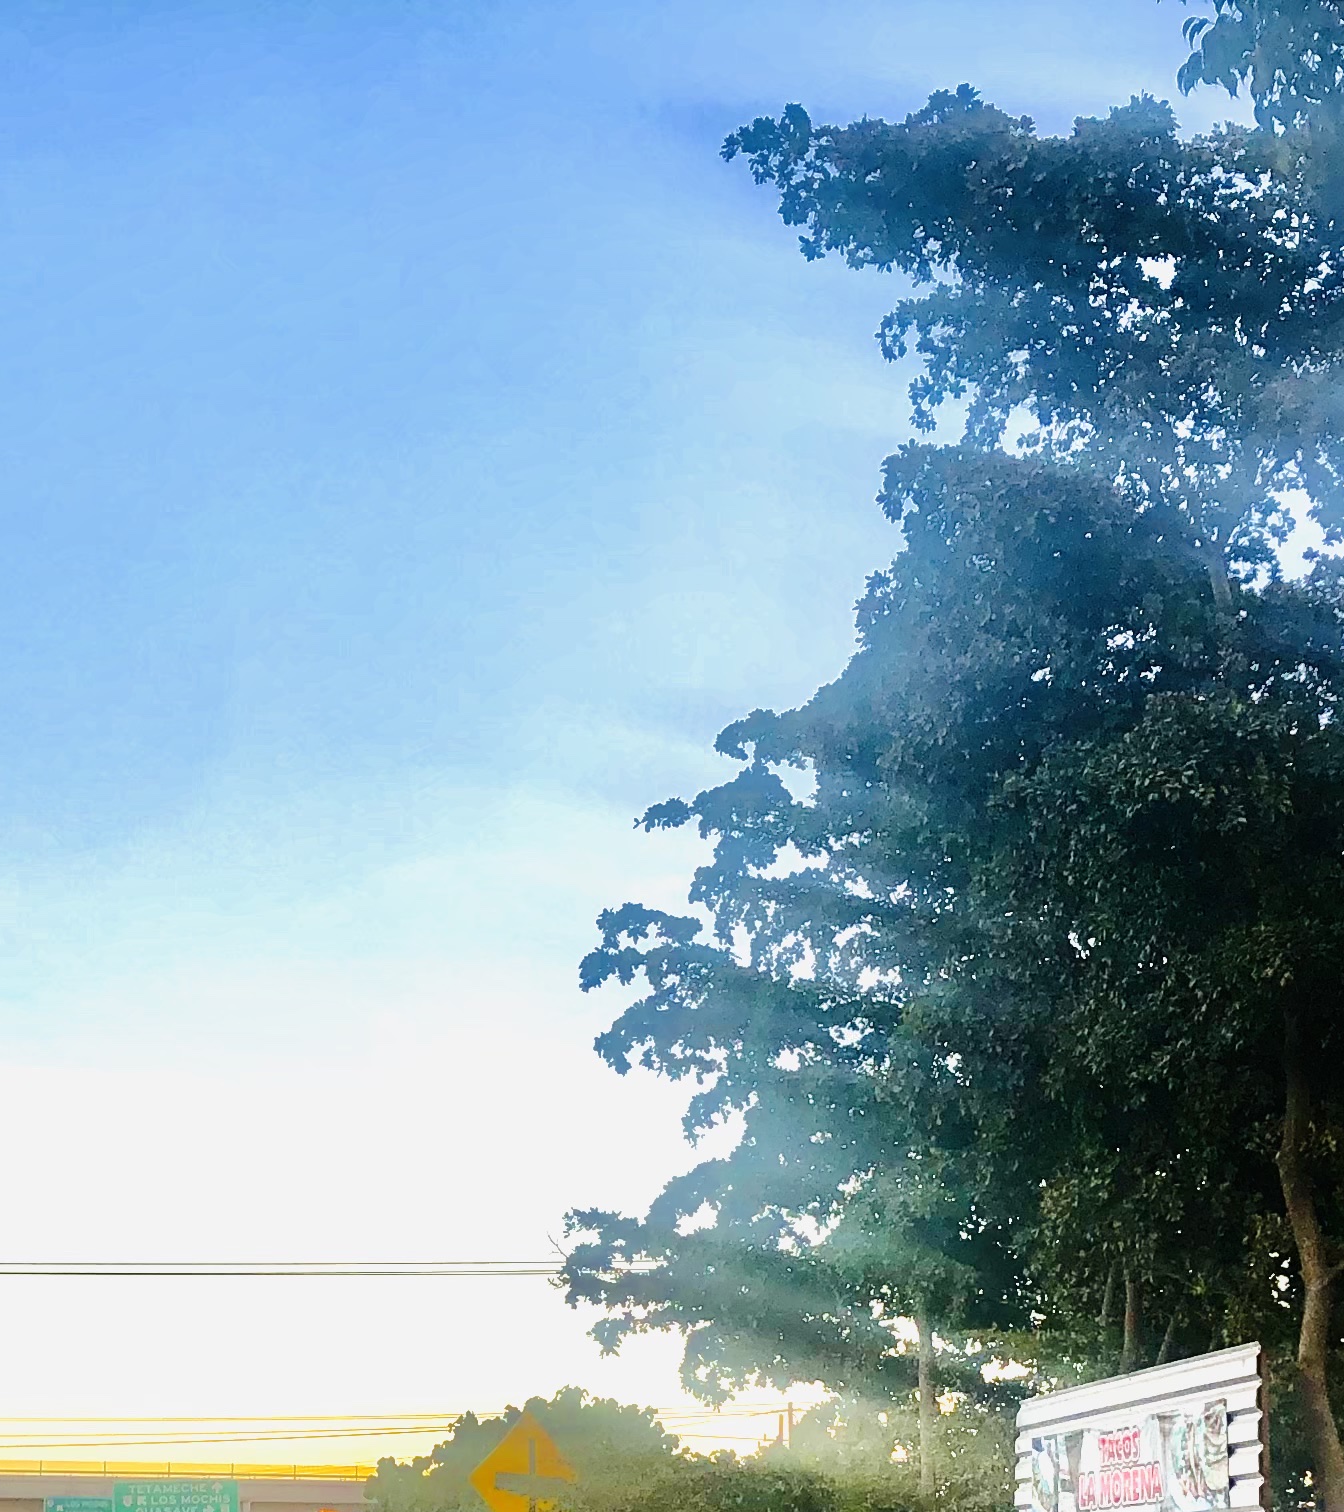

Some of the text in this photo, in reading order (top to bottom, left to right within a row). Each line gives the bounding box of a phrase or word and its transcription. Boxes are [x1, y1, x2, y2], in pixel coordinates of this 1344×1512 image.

[1098, 1429, 1141, 1466] TACOS
[128, 1483, 207, 1494] TETAMECHE
[151, 1494, 231, 1505] LOS MOCHIS
[1079, 1463, 1164, 1512] LA MORENA
